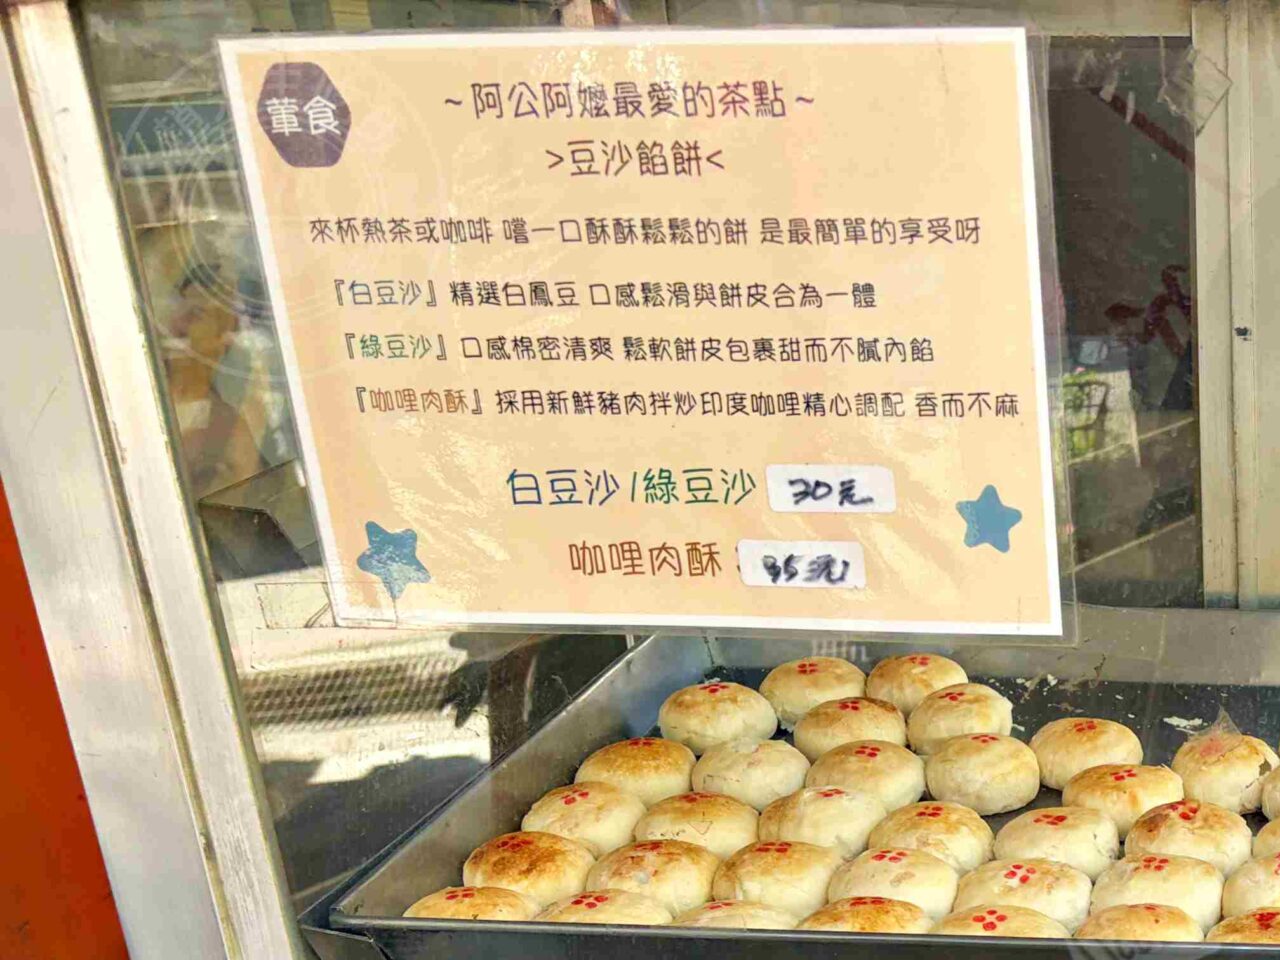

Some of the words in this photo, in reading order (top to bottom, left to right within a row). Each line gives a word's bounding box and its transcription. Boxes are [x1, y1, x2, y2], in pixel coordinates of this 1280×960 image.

[266, 95, 342, 138] 葷食
[544, 139, 727, 177] >豆沙餡餅<
[309, 216, 494, 245] 來杯熱茶或咖啡
[502, 216, 748, 246] 嚐一口酥酥鬆鬆的餅
[760, 216, 981, 246] 是最簡單的享受呀
[588, 281, 878, 309] 口感鬆滑與餅皮合為一體
[914, 391, 1020, 418] 香而不麻
[568, 540, 722, 579] 咖哩肉酥
